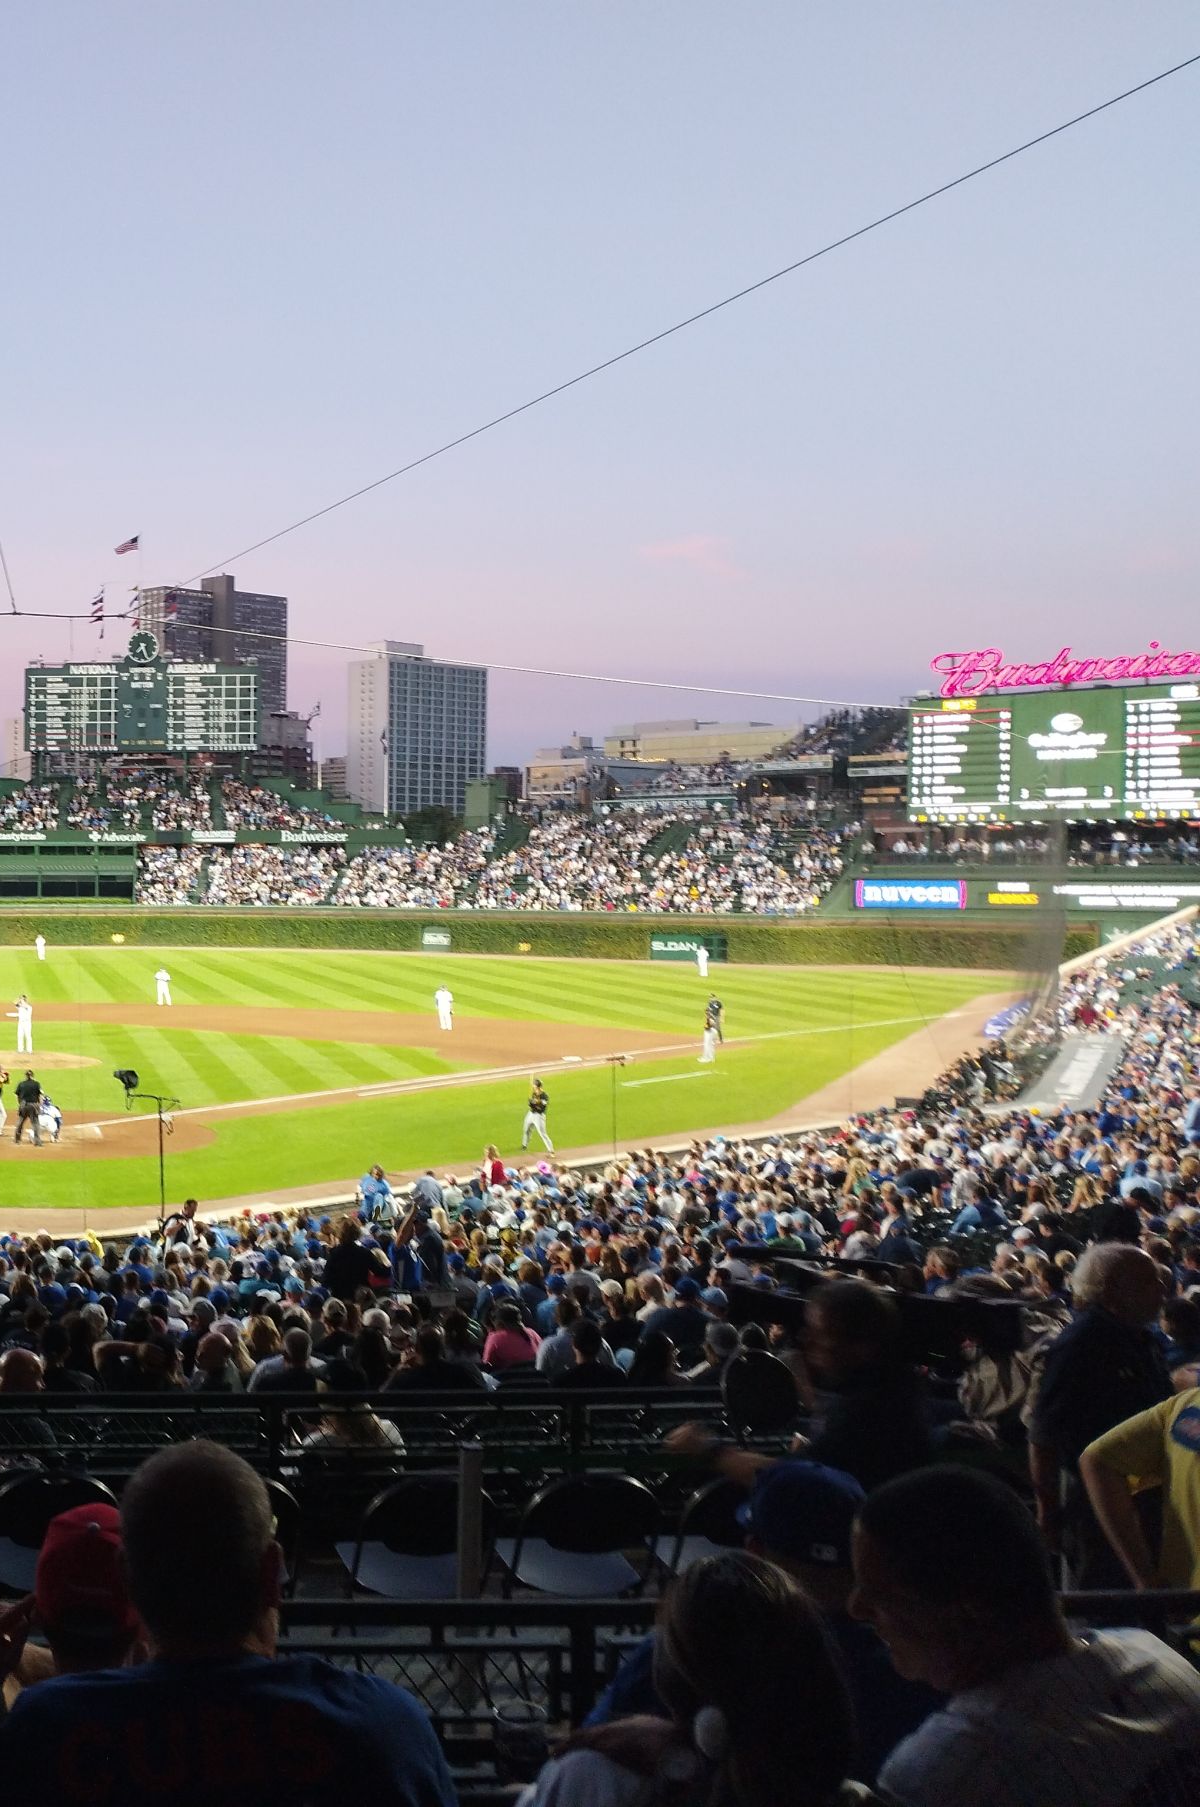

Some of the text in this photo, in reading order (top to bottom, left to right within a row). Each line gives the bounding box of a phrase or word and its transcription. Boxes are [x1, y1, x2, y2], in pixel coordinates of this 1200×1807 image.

[69, 665, 118, 674] NATIONAL
[166, 664, 216, 674] AMERICAN
[102, 832, 147, 842] Advocate
[280, 830, 349, 842] Budweiser
[863, 885, 960, 903] nuveen
[651, 940, 698, 951] SLOAN
